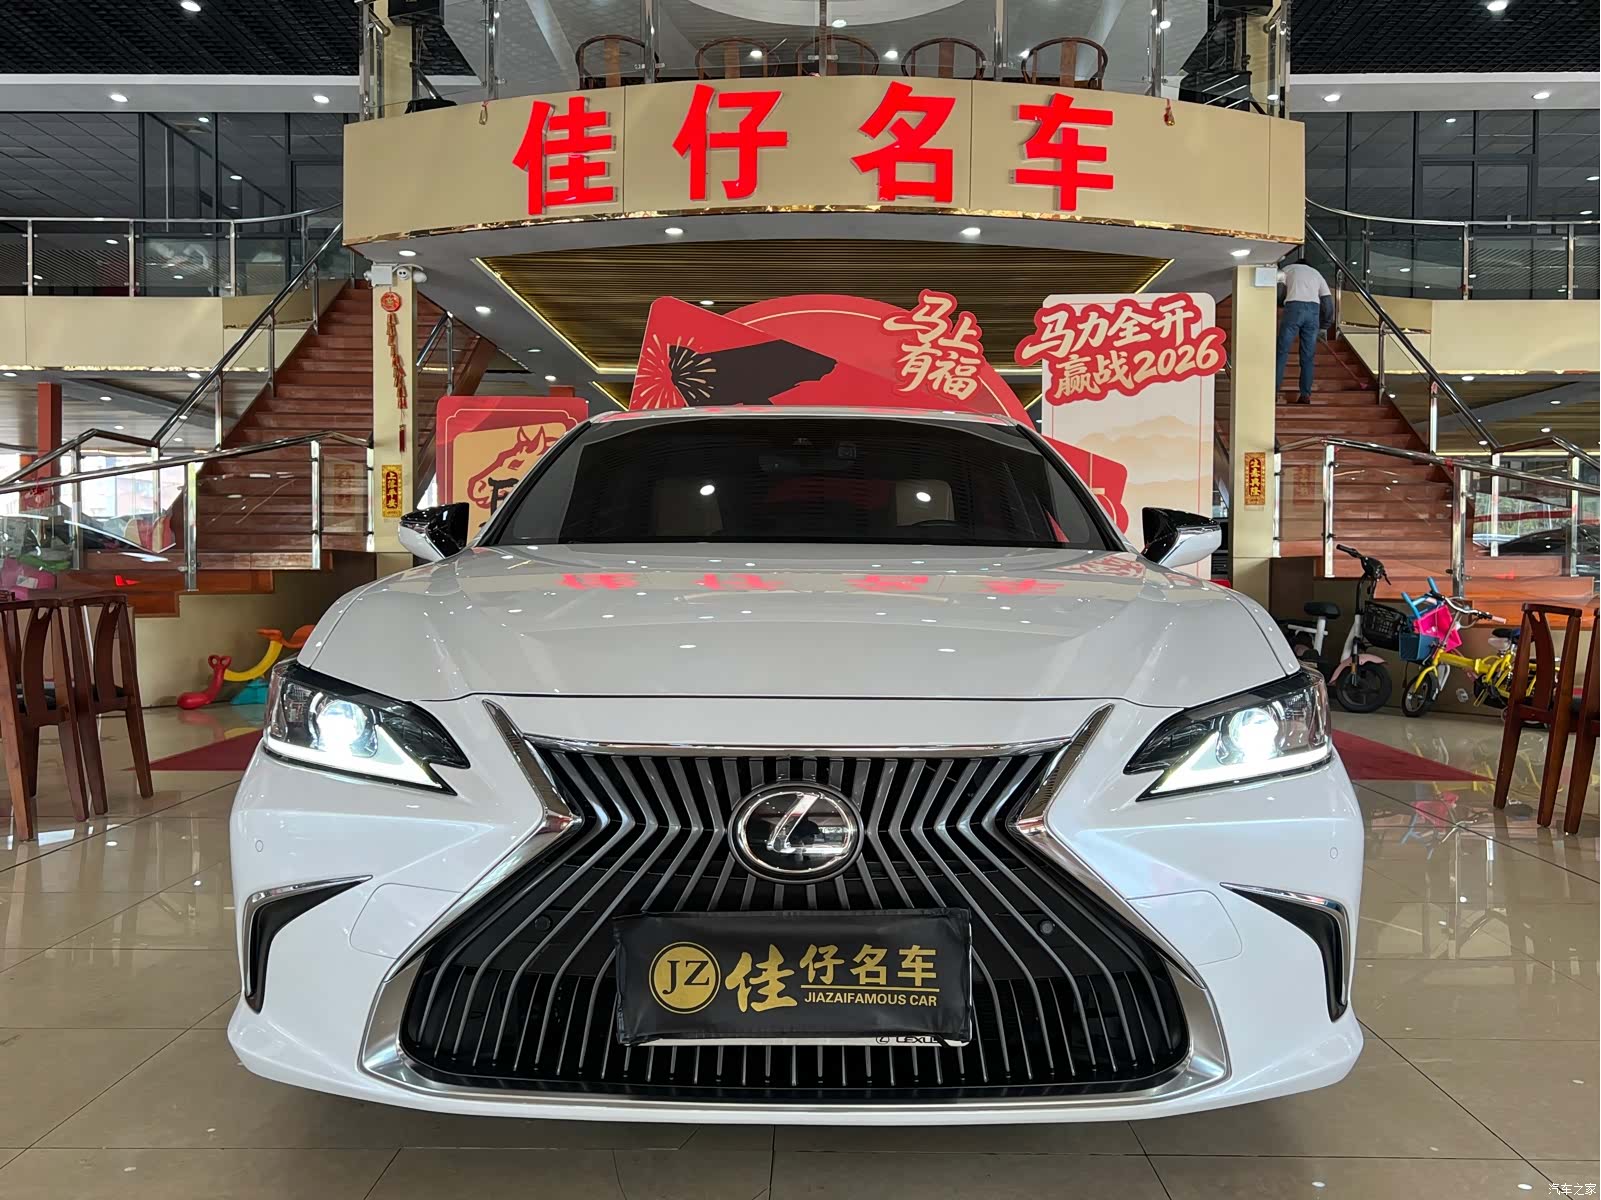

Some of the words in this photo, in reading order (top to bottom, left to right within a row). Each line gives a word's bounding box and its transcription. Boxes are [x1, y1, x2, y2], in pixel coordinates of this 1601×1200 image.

[512, 82, 1116, 214] 佳仔名车
[882, 294, 982, 353] 马上
[1021, 300, 1195, 360] 马力全开
[897, 342, 983, 400] 有福
[1053, 334, 1221, 399] 赢战2026
[662, 959, 711, 995] JZ
[725, 943, 938, 1013] 佳仔名车
[804, 991, 907, 1005] JIAZAIFAMOUS
[908, 994, 938, 1008] CAR
